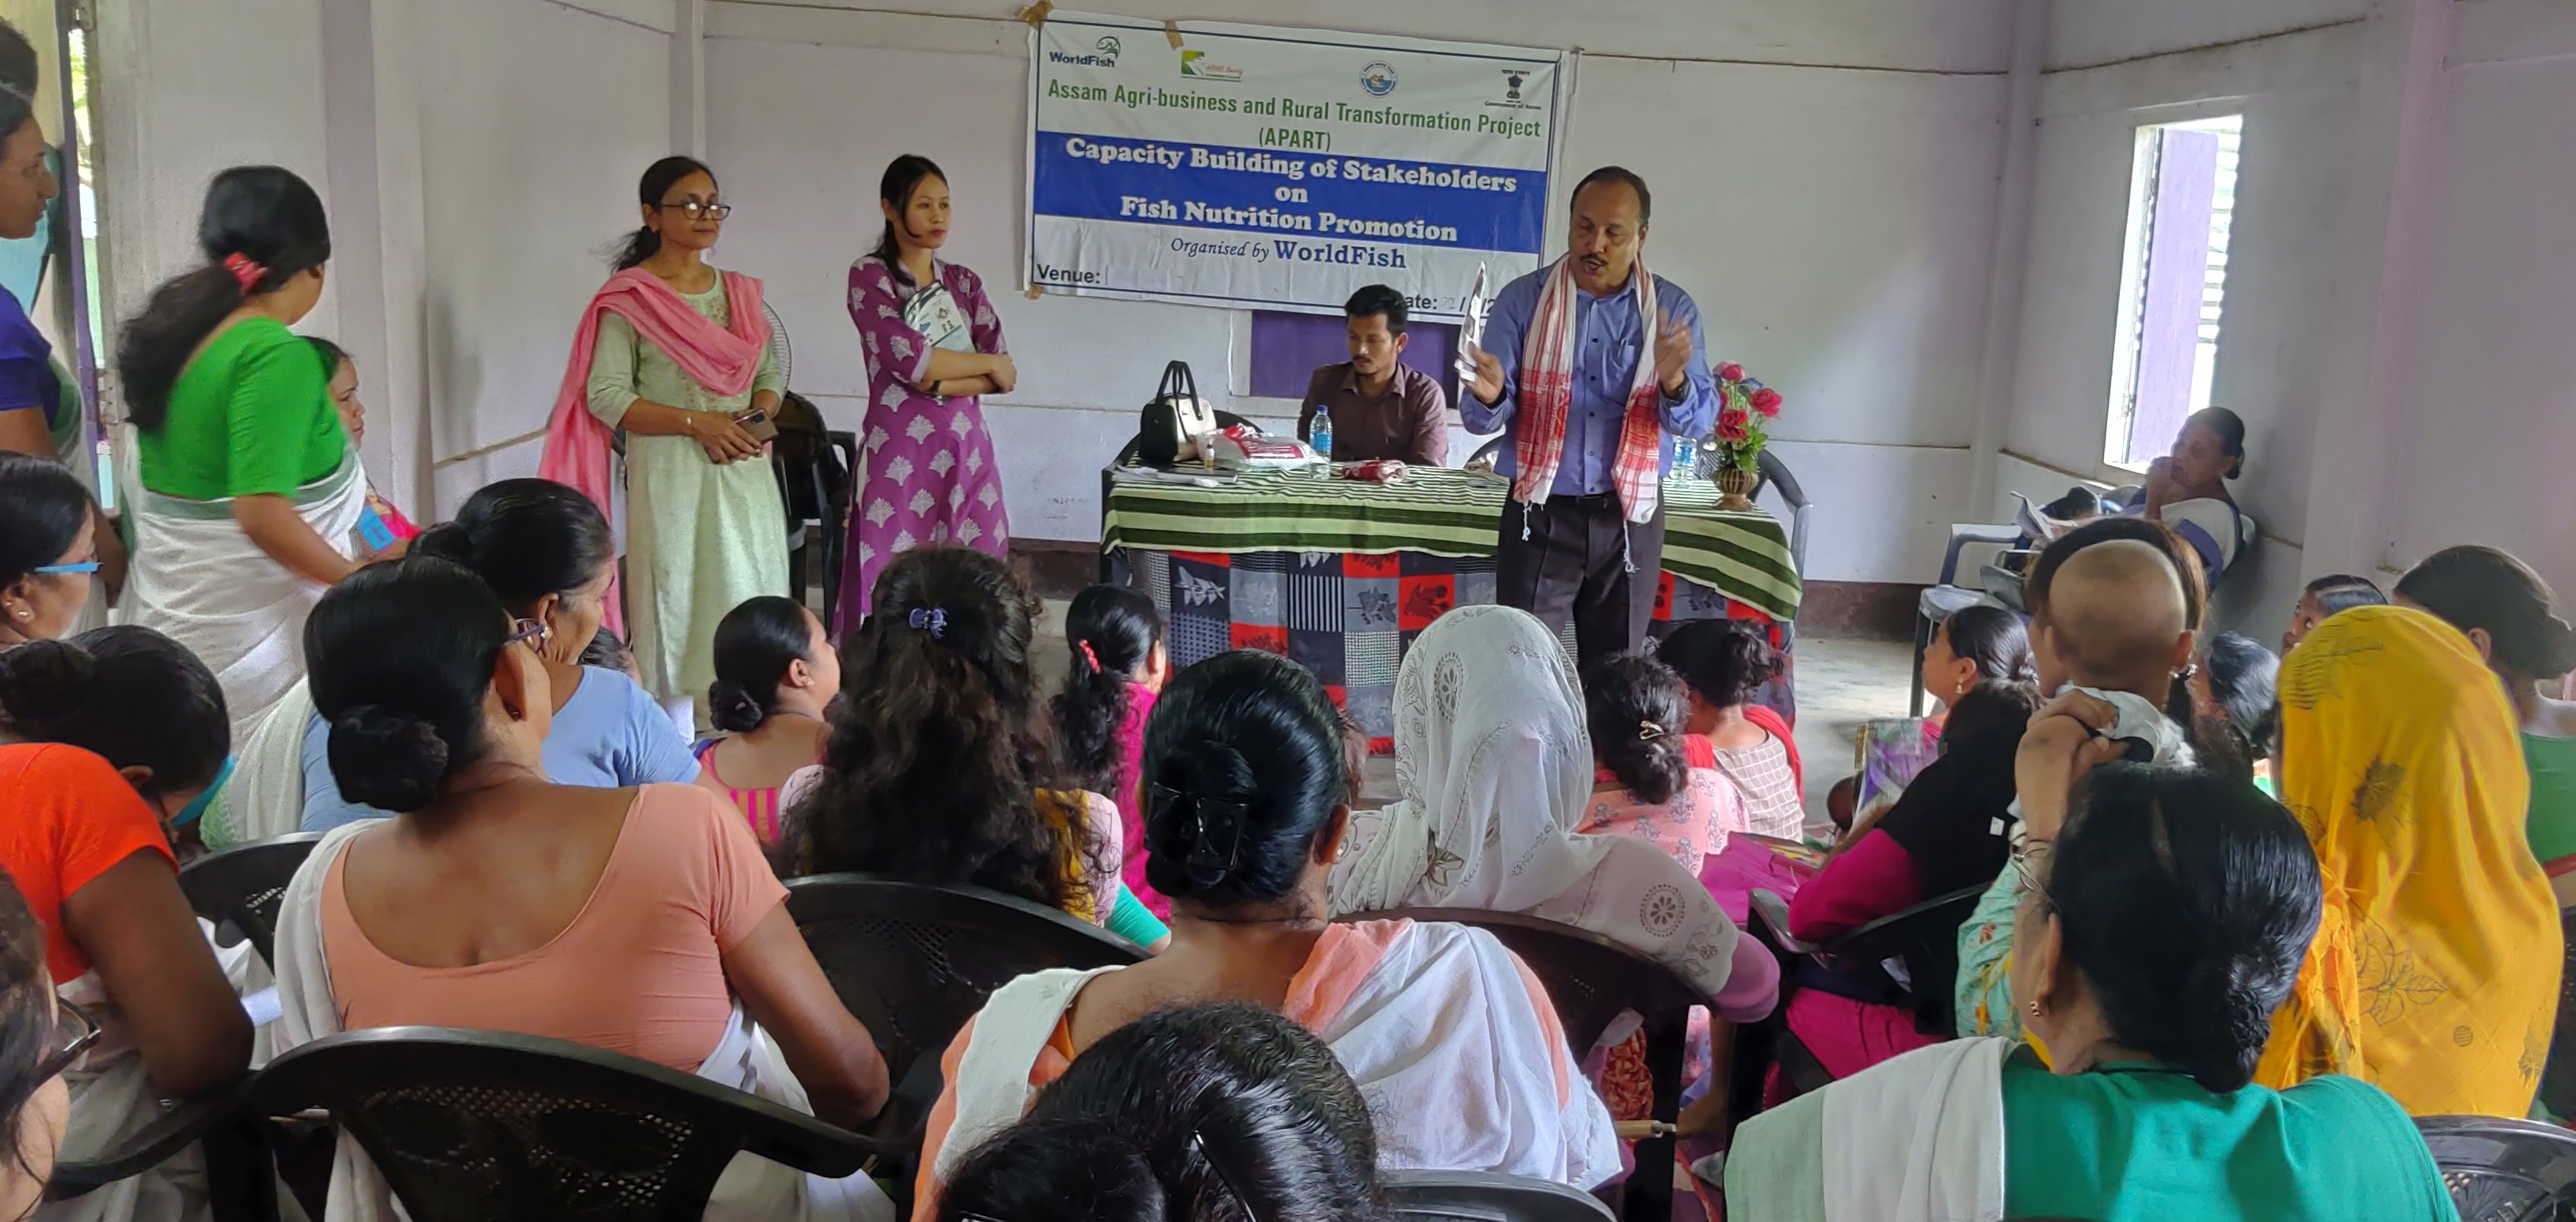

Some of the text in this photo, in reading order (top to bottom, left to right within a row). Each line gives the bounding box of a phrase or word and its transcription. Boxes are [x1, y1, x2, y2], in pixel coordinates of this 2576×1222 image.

[1049, 51, 1115, 68] WorldFish
[1048, 79, 1541, 139] Assam Agri-business and Rural Transformation Project
[1259, 127, 1331, 152] (APART)
[1066, 137, 1517, 192] Capacity Building of Stakeholders
[1275, 186, 1308, 203] on
[1120, 195, 1458, 242] Fish Nutrition Promotion
[1171, 238, 1407, 268] Organised by WorldFish
[1037, 265, 1100, 284] Venue:
[1404, 294, 1438, 310] ate:
